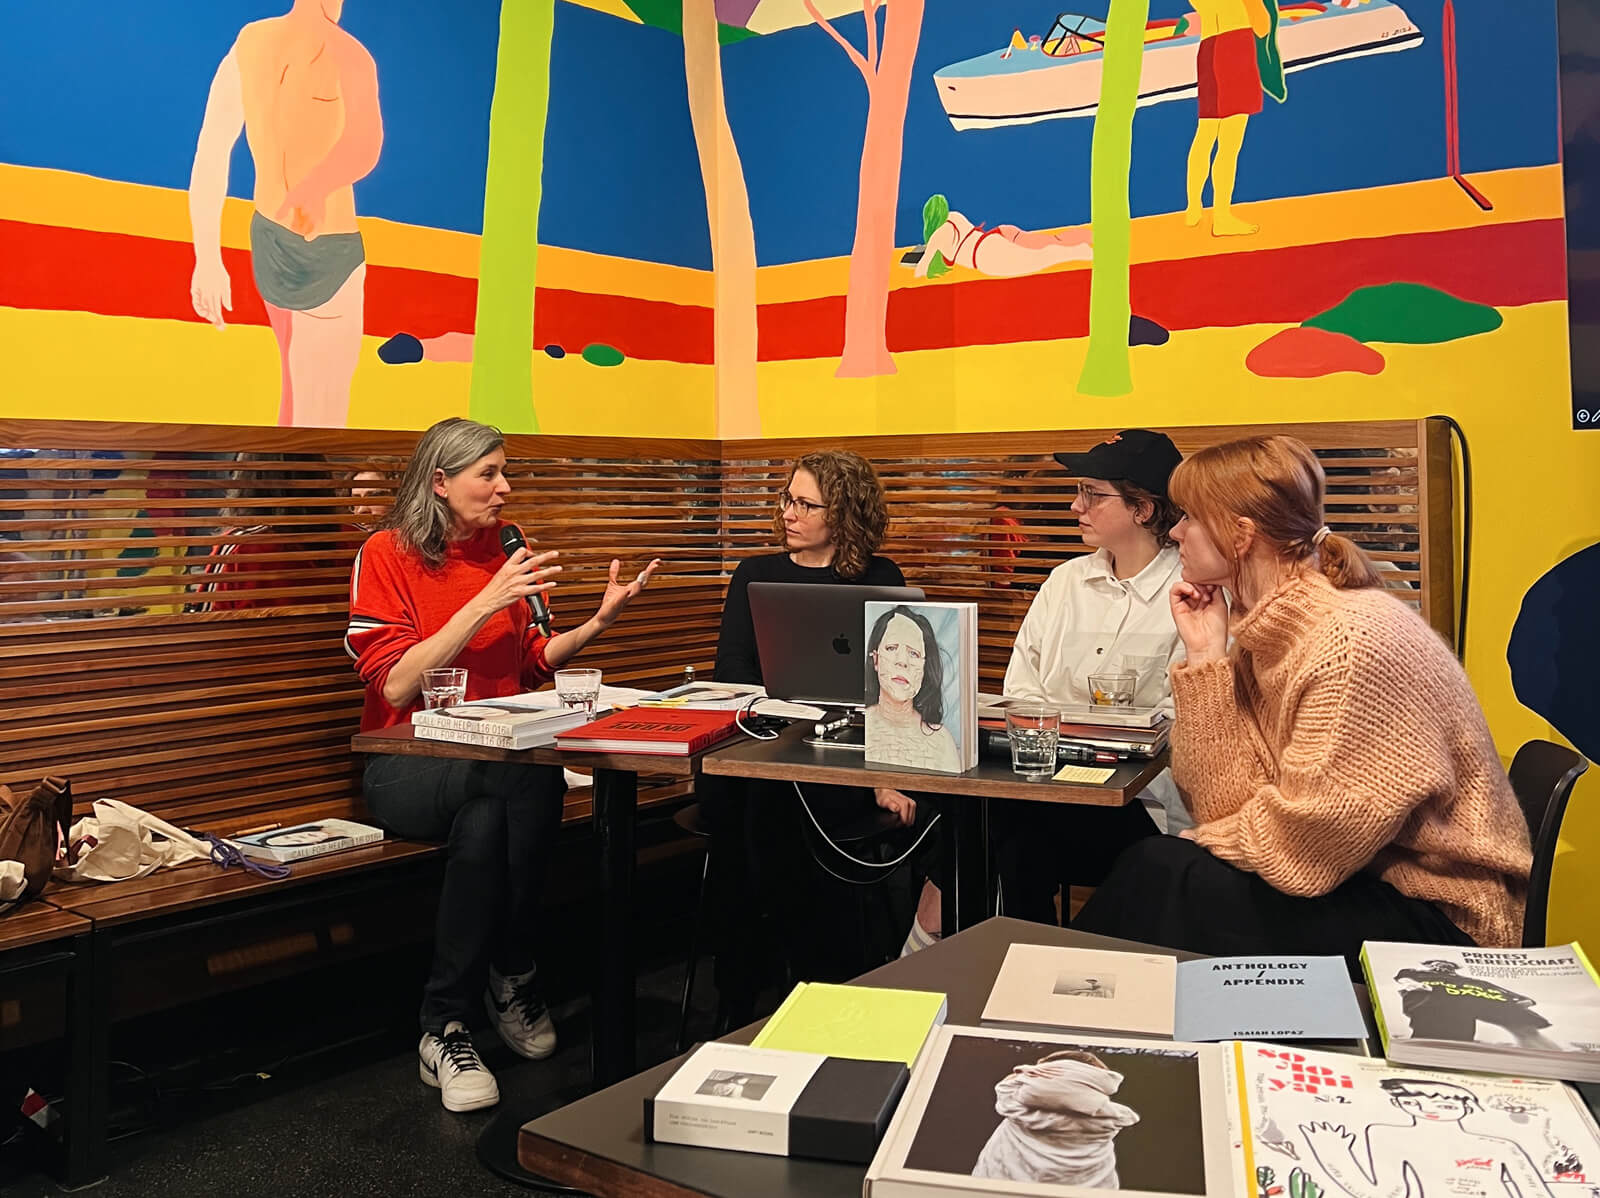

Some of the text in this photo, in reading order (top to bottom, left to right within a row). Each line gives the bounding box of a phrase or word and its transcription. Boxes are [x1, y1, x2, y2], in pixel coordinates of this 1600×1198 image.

[418, 715, 434, 726] CALL
[437, 718, 450, 728] FOR
[421, 727, 438, 738] CALL
[441, 731, 456, 741] FOR
[1461, 952, 1527, 960] PROTEST
[1464, 957, 1574, 966] BEREITSCHAFT
[1257, 970, 1266, 978] /
